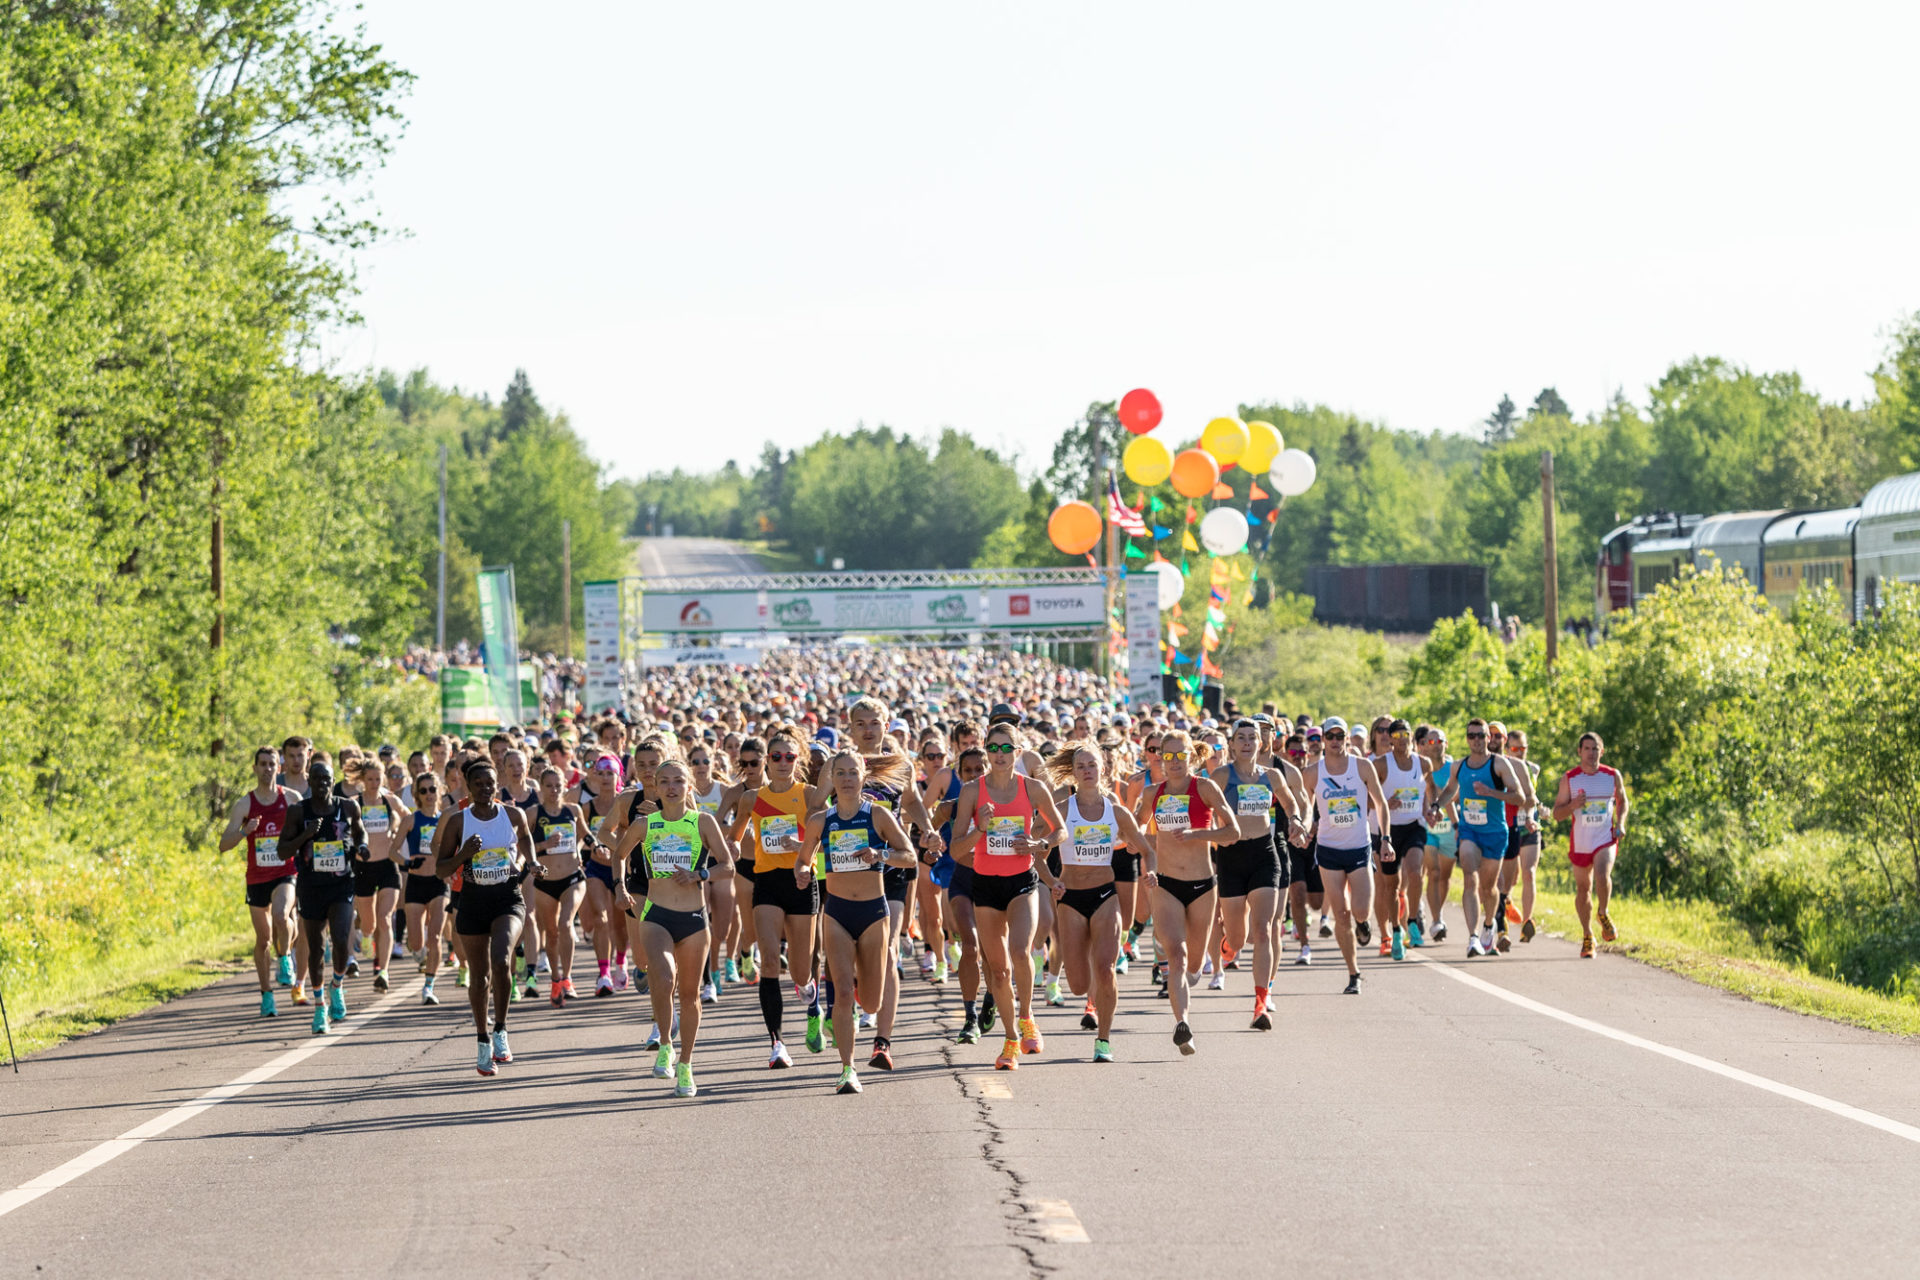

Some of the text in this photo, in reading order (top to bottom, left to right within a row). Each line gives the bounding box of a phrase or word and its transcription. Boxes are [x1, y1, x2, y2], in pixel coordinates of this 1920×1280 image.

[1035, 599, 1085, 610] TOYOTA
[835, 602, 913, 627] START
[1322, 785, 1358, 799] Carolina
[1155, 814, 1190, 824] Sullivan
[1334, 814, 1354, 824] 6863
[989, 837, 1014, 848] Selle
[1075, 845, 1110, 857] Vaughn
[320, 858, 339, 867] 4427
[652, 853, 691, 864] Lindwurm
[474, 867, 509, 880] Wanjiru
